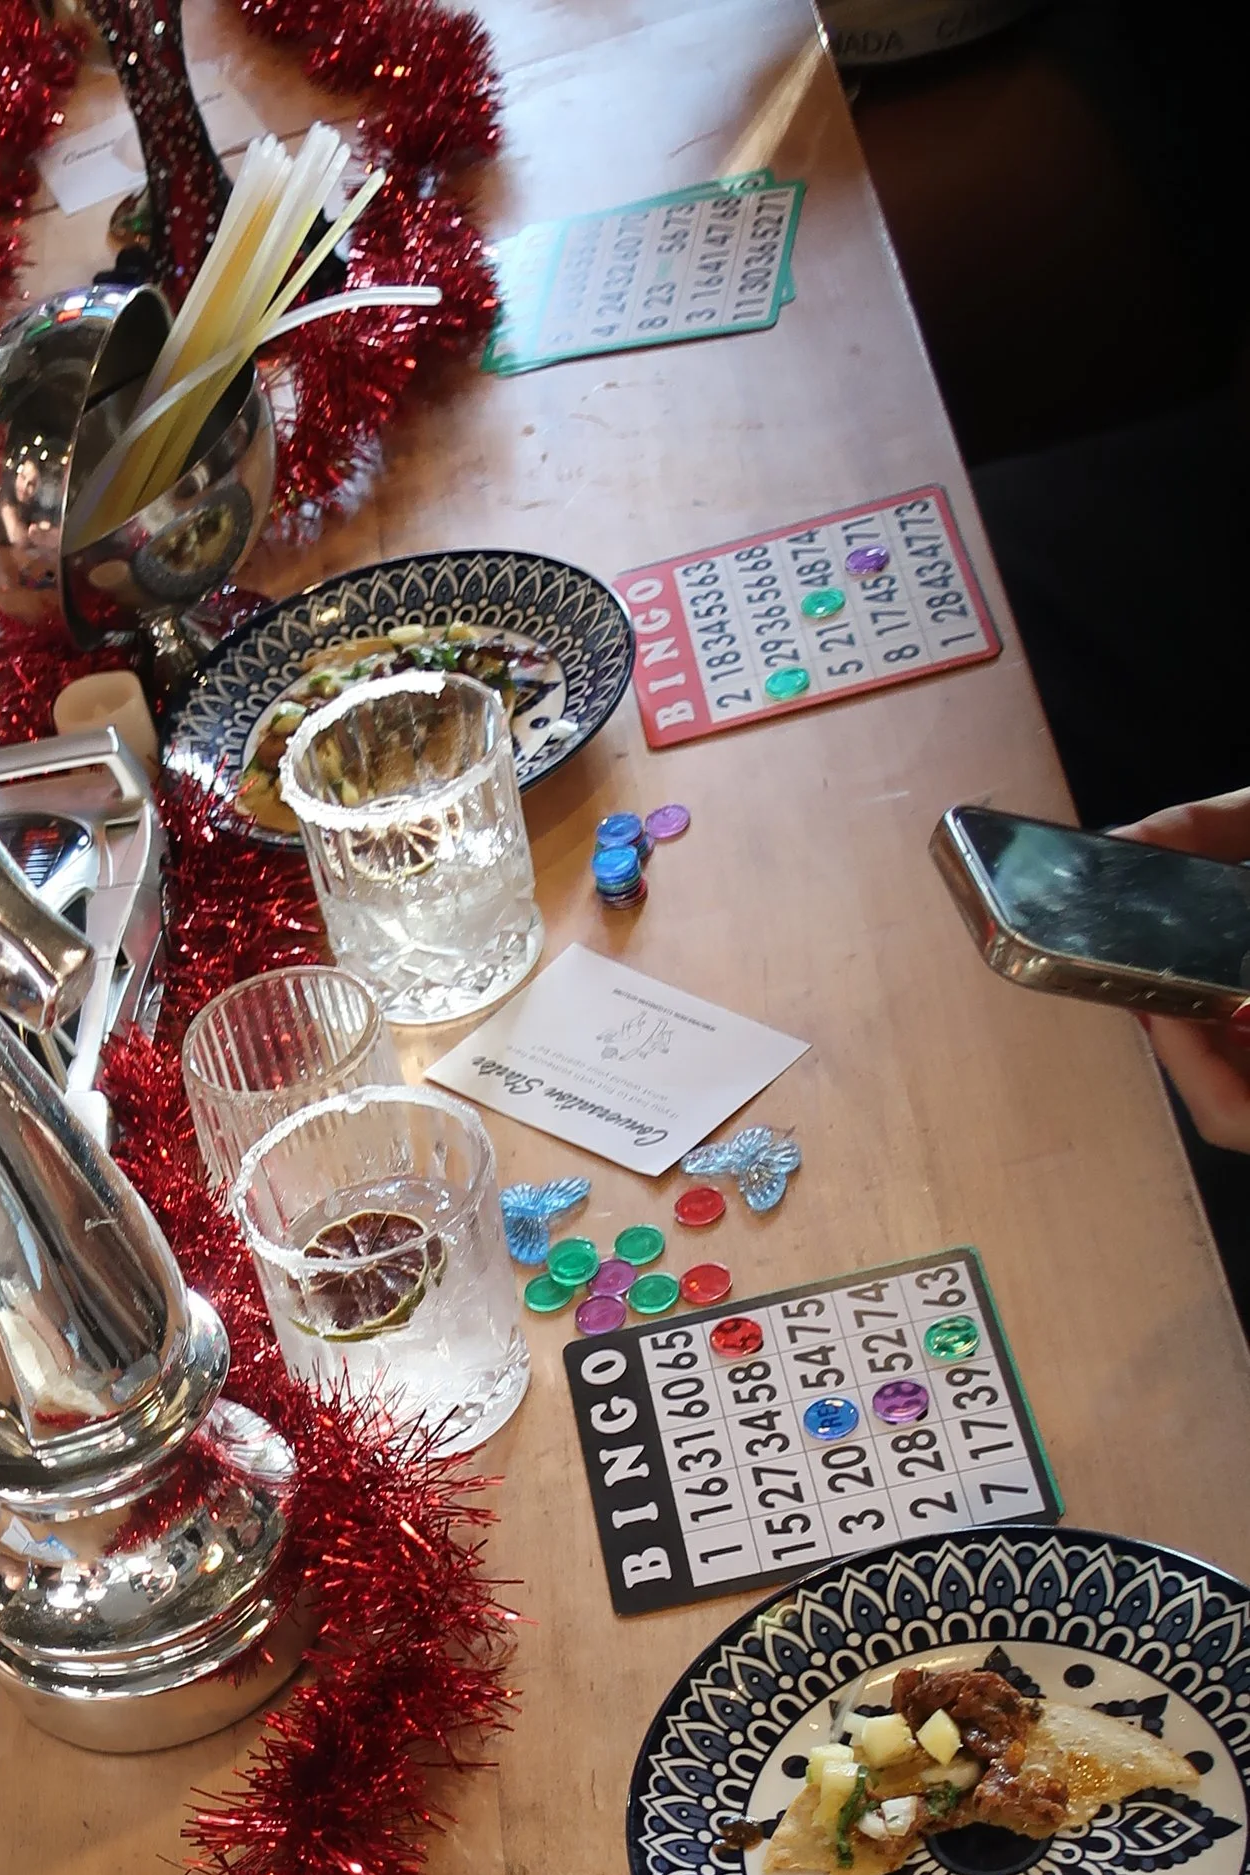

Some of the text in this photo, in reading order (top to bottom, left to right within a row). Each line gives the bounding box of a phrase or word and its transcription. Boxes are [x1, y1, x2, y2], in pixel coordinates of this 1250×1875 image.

[681, 559, 752, 709] 2 18 34 53 63
[734, 544, 800, 668] 29 36 56 68
[787, 529, 864, 677] 5 21 48 74
[894, 499, 977, 647] 1 28 43 47 73
[626, 578, 695, 732] BINGO
[472, 1056, 544, 1096] Starter
[547, 1087, 669, 1148] Conversation
[650, 1330, 743, 1564] 1 16 31 60 65
[727, 1360, 816, 1561] 15 27 34 58
[781, 1298, 885, 1535] 3 20 54 75
[915, 1266, 1029, 1505] 7 17 39 63
[580, 1348, 672, 1590] BINGO
